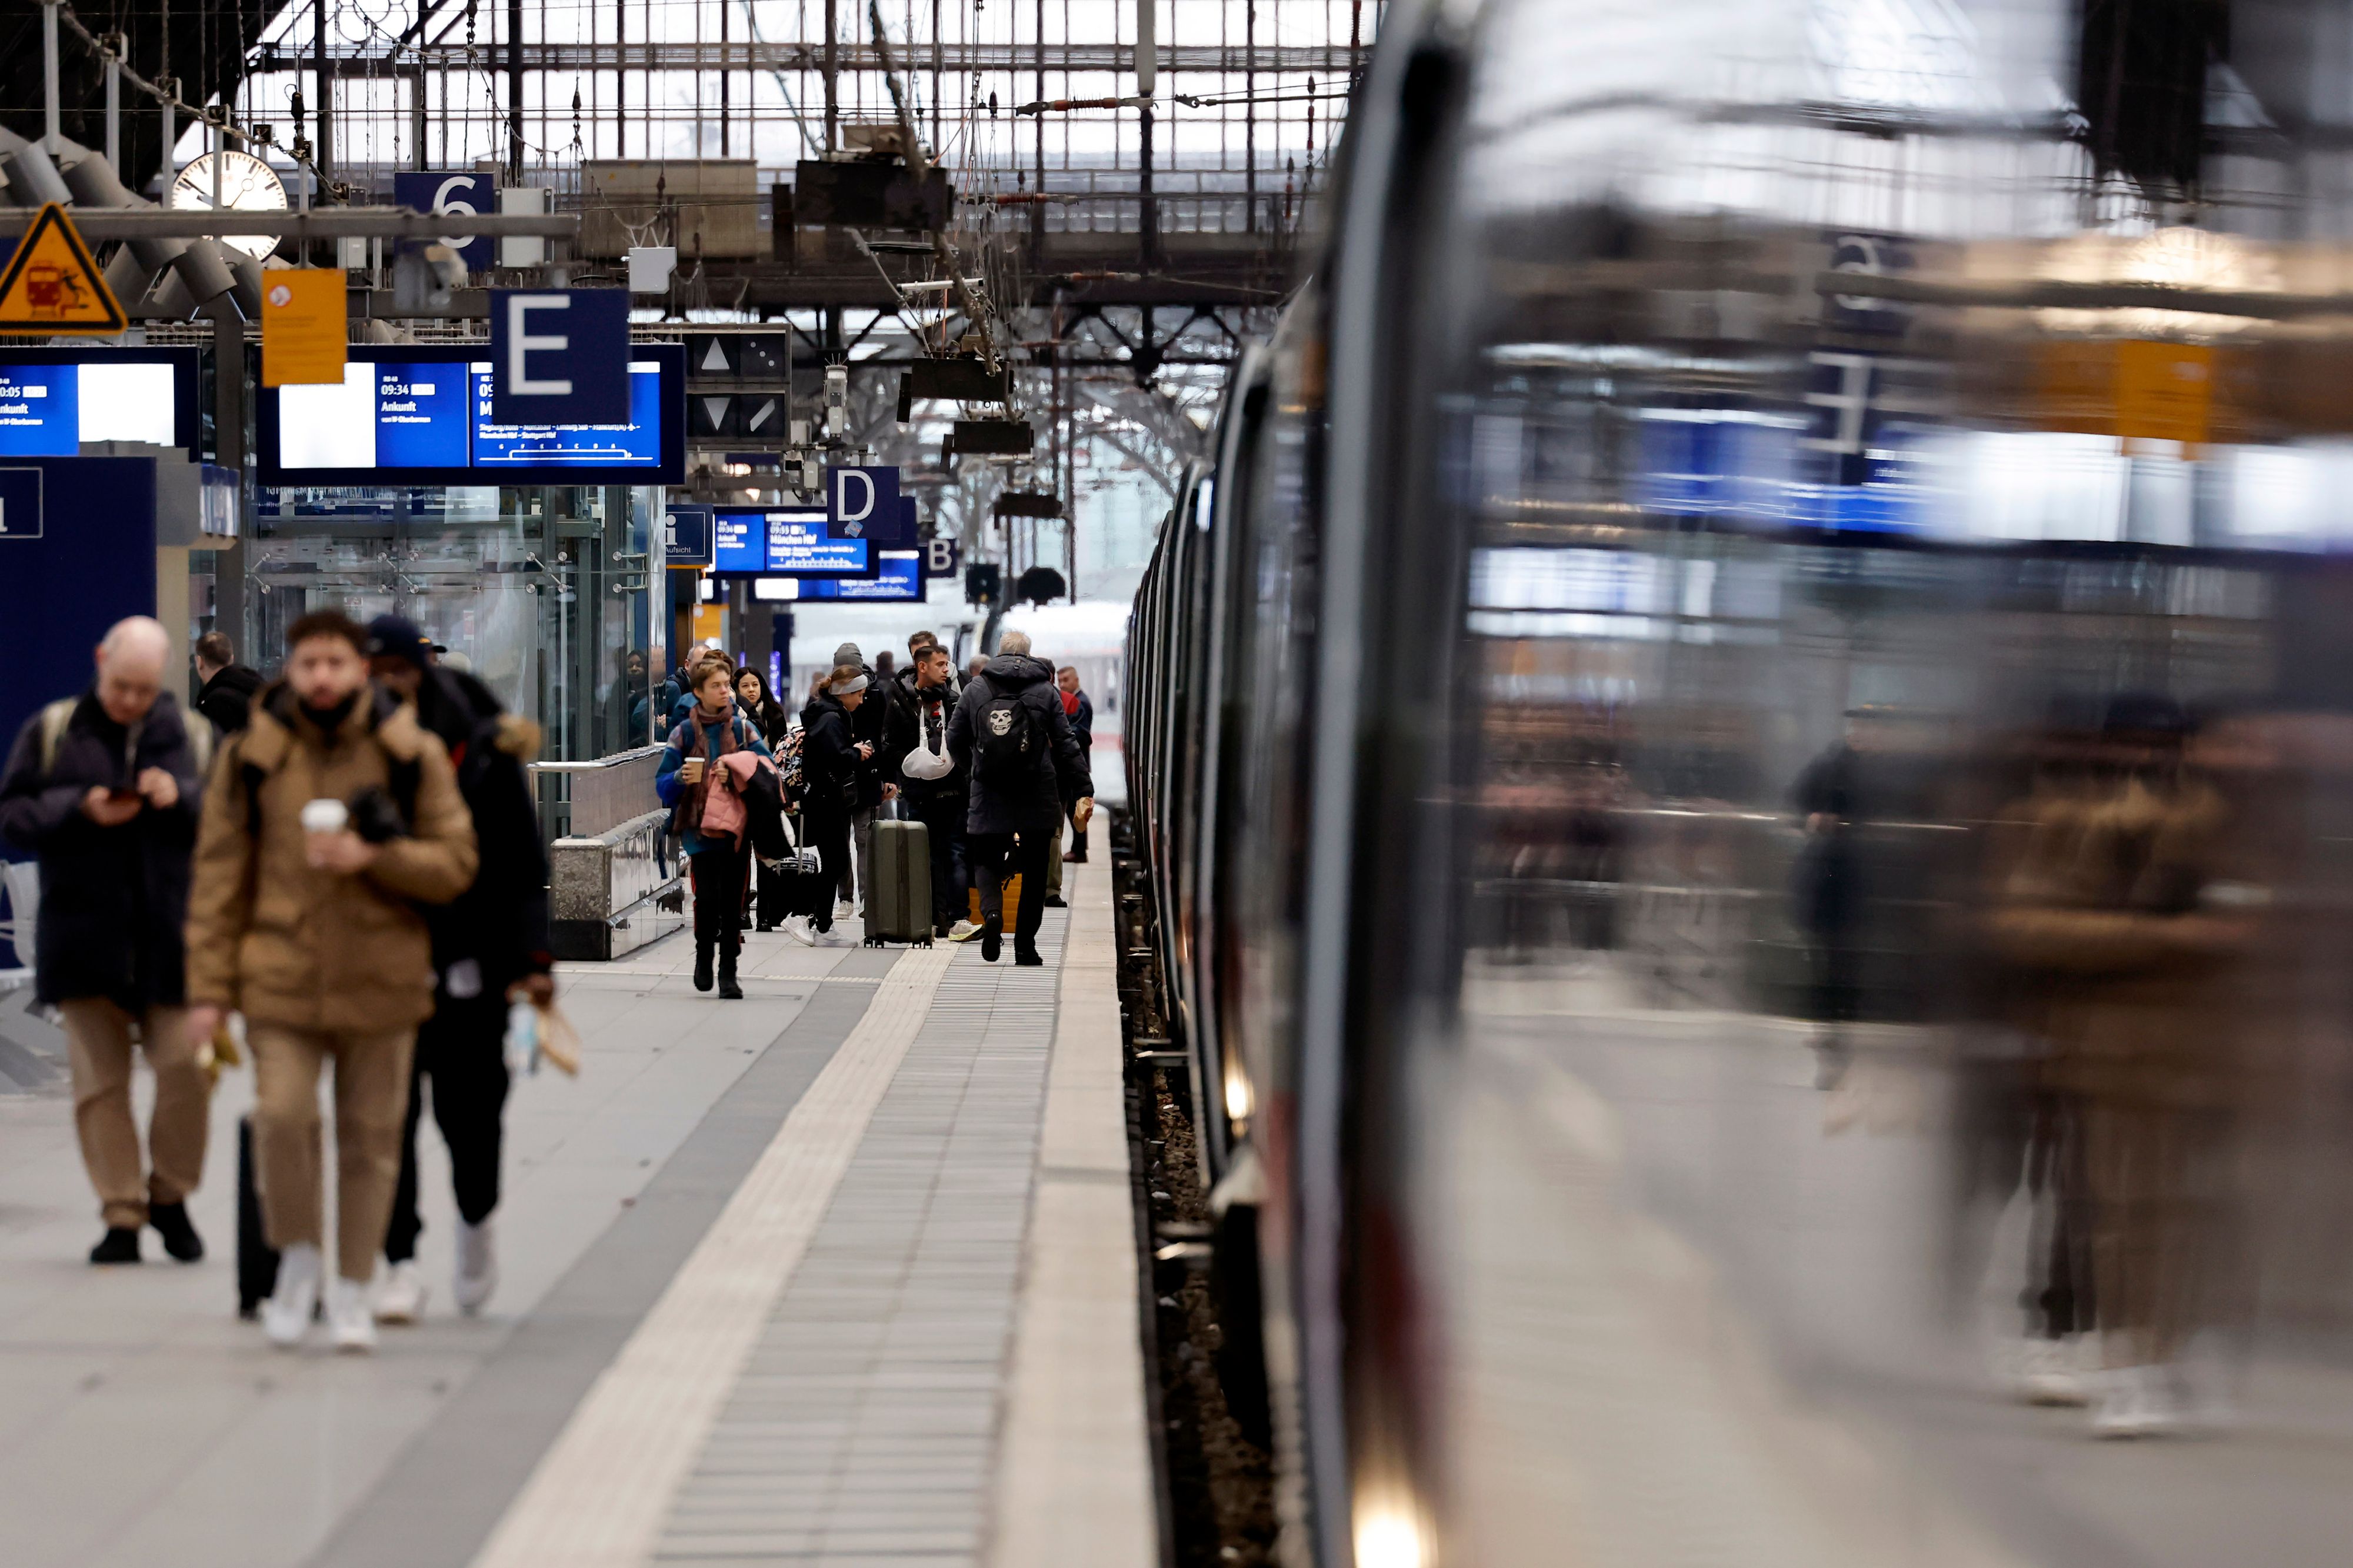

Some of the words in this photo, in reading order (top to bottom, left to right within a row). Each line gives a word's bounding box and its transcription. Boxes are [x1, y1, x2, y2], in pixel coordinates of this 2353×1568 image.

[433, 176, 478, 249] 6
[508, 295, 573, 395] E
[0, 386, 21, 398] 0:05
[381, 384, 409, 395] 09:34
[0, 403, 28, 414] nkunft
[381, 401, 416, 412] Ankunft
[838, 469, 875, 521] D
[928, 539, 952, 571] B
